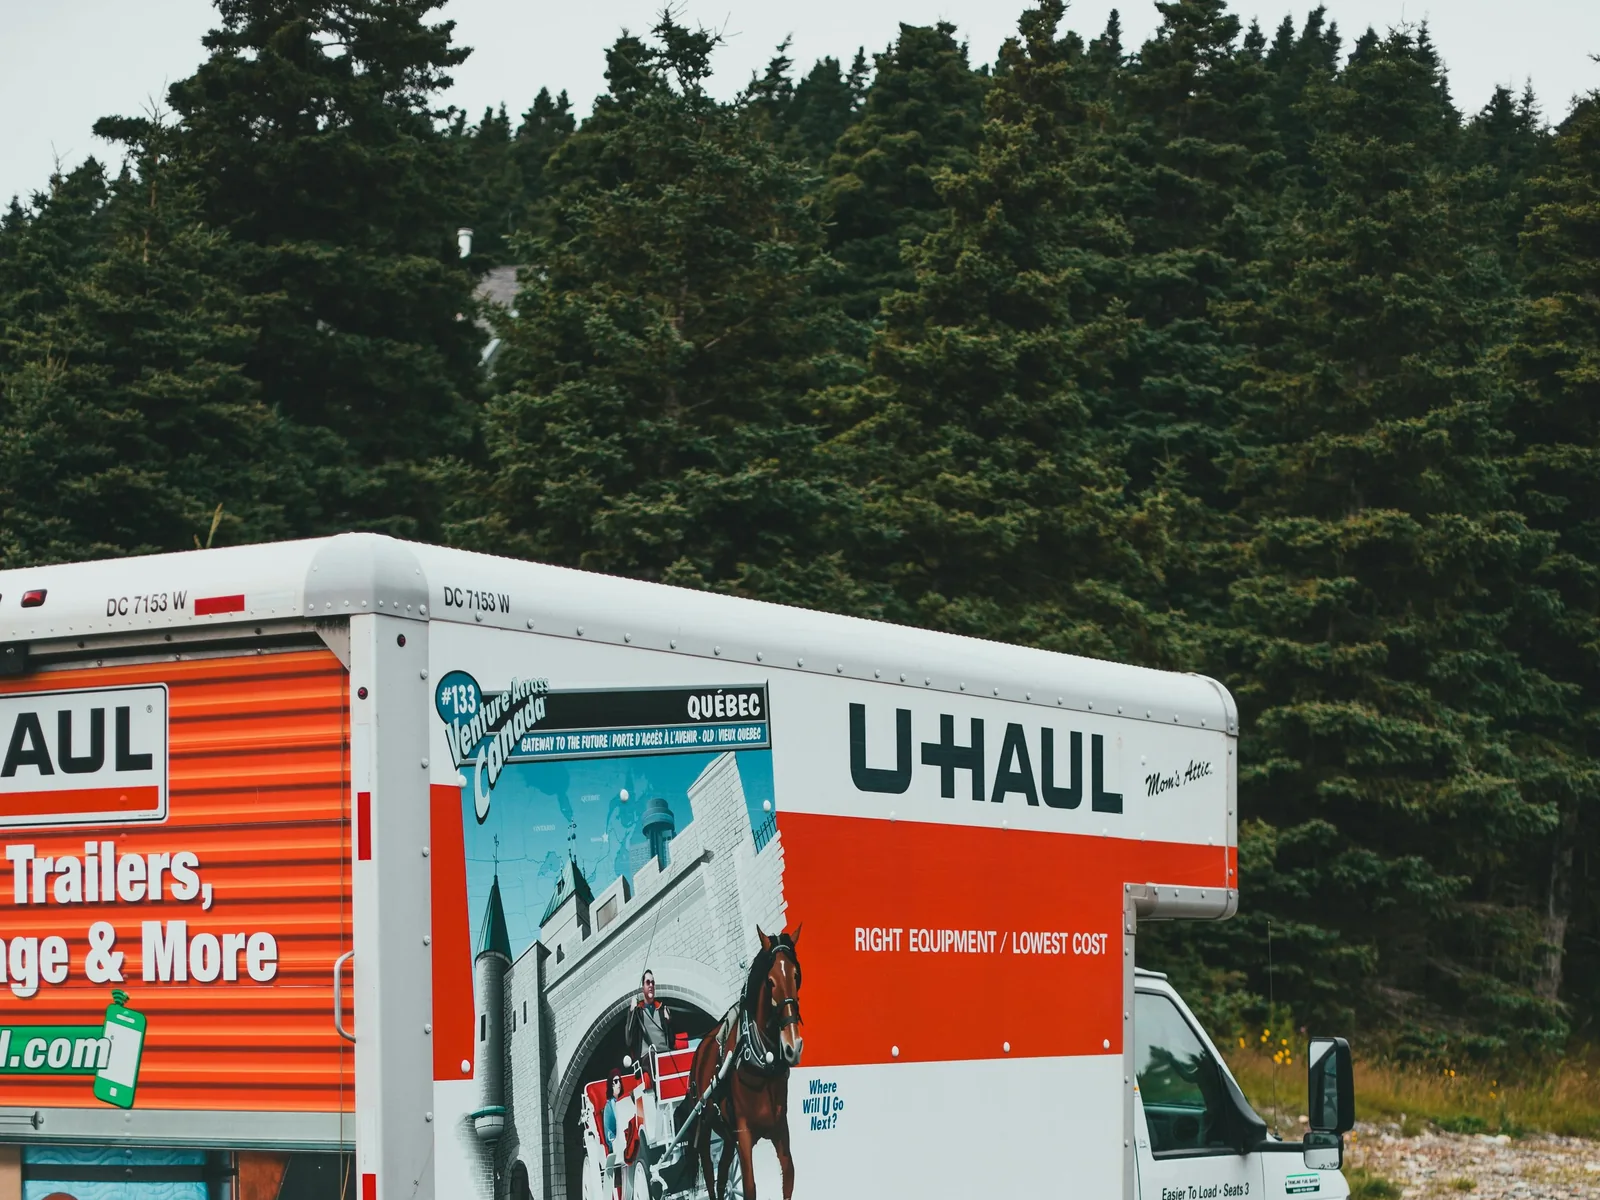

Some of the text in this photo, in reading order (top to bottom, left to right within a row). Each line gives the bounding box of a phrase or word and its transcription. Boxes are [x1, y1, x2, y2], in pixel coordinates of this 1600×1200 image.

[107, 591, 187, 617] DC 7153 W
[444, 586, 509, 613] DC 7153 W
[441, 685, 476, 714] #133
[687, 689, 760, 720] QUÉBEC
[445, 677, 549, 769] Venture Across
[521, 736, 554, 752] GATEWAY
[556, 736, 565, 750] TO
[567, 735, 580, 750] THE
[582, 734, 608, 749] FUTURE
[612, 732, 634, 748] PORTE
[664, 729, 669, 745] À
[670, 729, 698, 745] L'AVENIR
[702, 730, 714, 743] OLD
[719, 728, 736, 742] VIEUX
[474, 695, 546, 822] Canada
[849, 702, 1123, 814] U-HAUL
[1145, 770, 1180, 797] Mom's
[6, 841, 213, 911] Trailers,
[85, 921, 124, 983] &
[142, 920, 278, 982] More
[855, 927, 903, 952] RIGHT
[909, 929, 997, 954] EQUIPMENT
[1012, 931, 1068, 955] LOWEST
[1072, 932, 1108, 955] COST
[809, 1079, 837, 1095] Where
[803, 1096, 844, 1116] Will U Go
[810, 1113, 837, 1131] Next?
[1188, 1186, 1197, 1200] To
[1198, 1184, 1218, 1199] Load
[1223, 1183, 1244, 1197] Seats
[1244, 1182, 1250, 1195] 3
